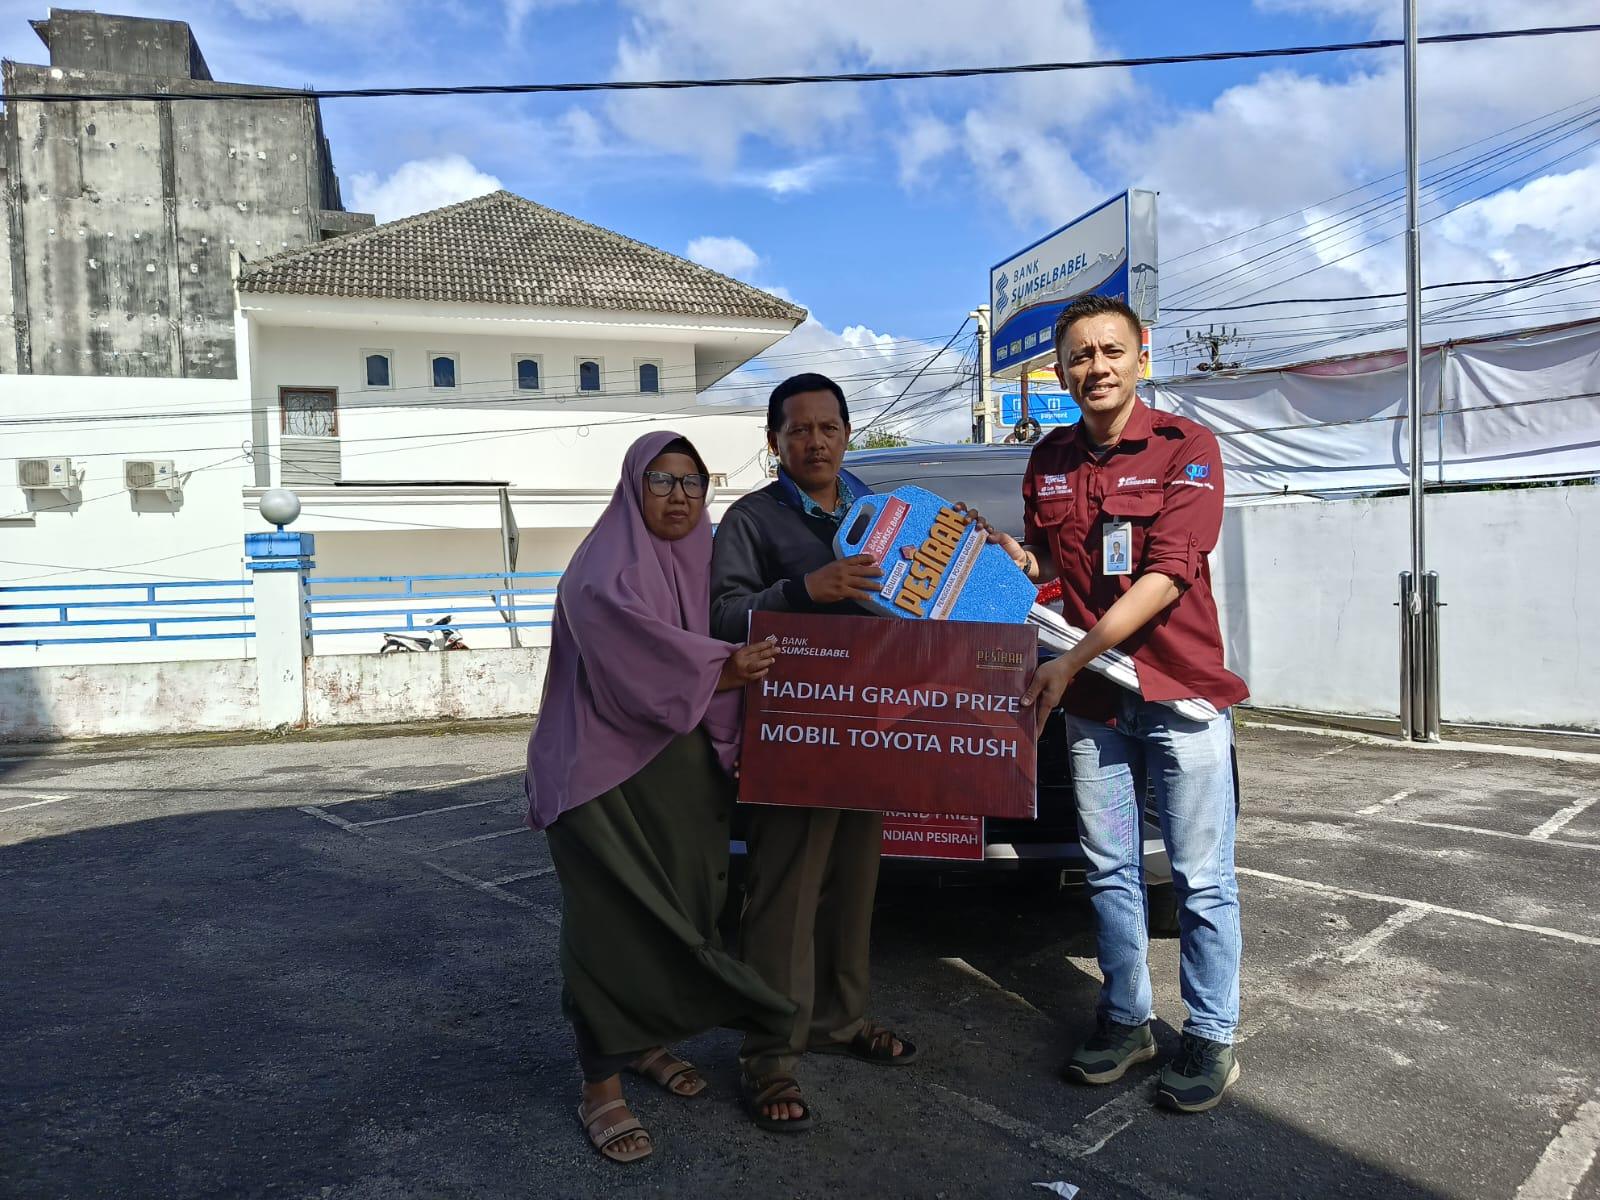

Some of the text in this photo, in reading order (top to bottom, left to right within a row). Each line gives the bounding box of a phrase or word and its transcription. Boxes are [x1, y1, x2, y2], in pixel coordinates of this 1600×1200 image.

[1011, 252, 1088, 303] SUMSELBABEL
[1013, 259, 1039, 283] BANK
[868, 530, 884, 550] BANK
[876, 504, 906, 554] SUMSELBABEL
[895, 506, 968, 617] PESIRAH
[883, 561, 906, 598] tabungan
[780, 647, 850, 658] SUMSELBABEL
[781, 636, 809, 646] BANK
[763, 680, 1020, 713] HADIAH GRAND PRIZE
[760, 723, 1017, 758] MOBIL TOYOTA RUSH
[883, 829, 978, 845] NDIAN PESIRAH
